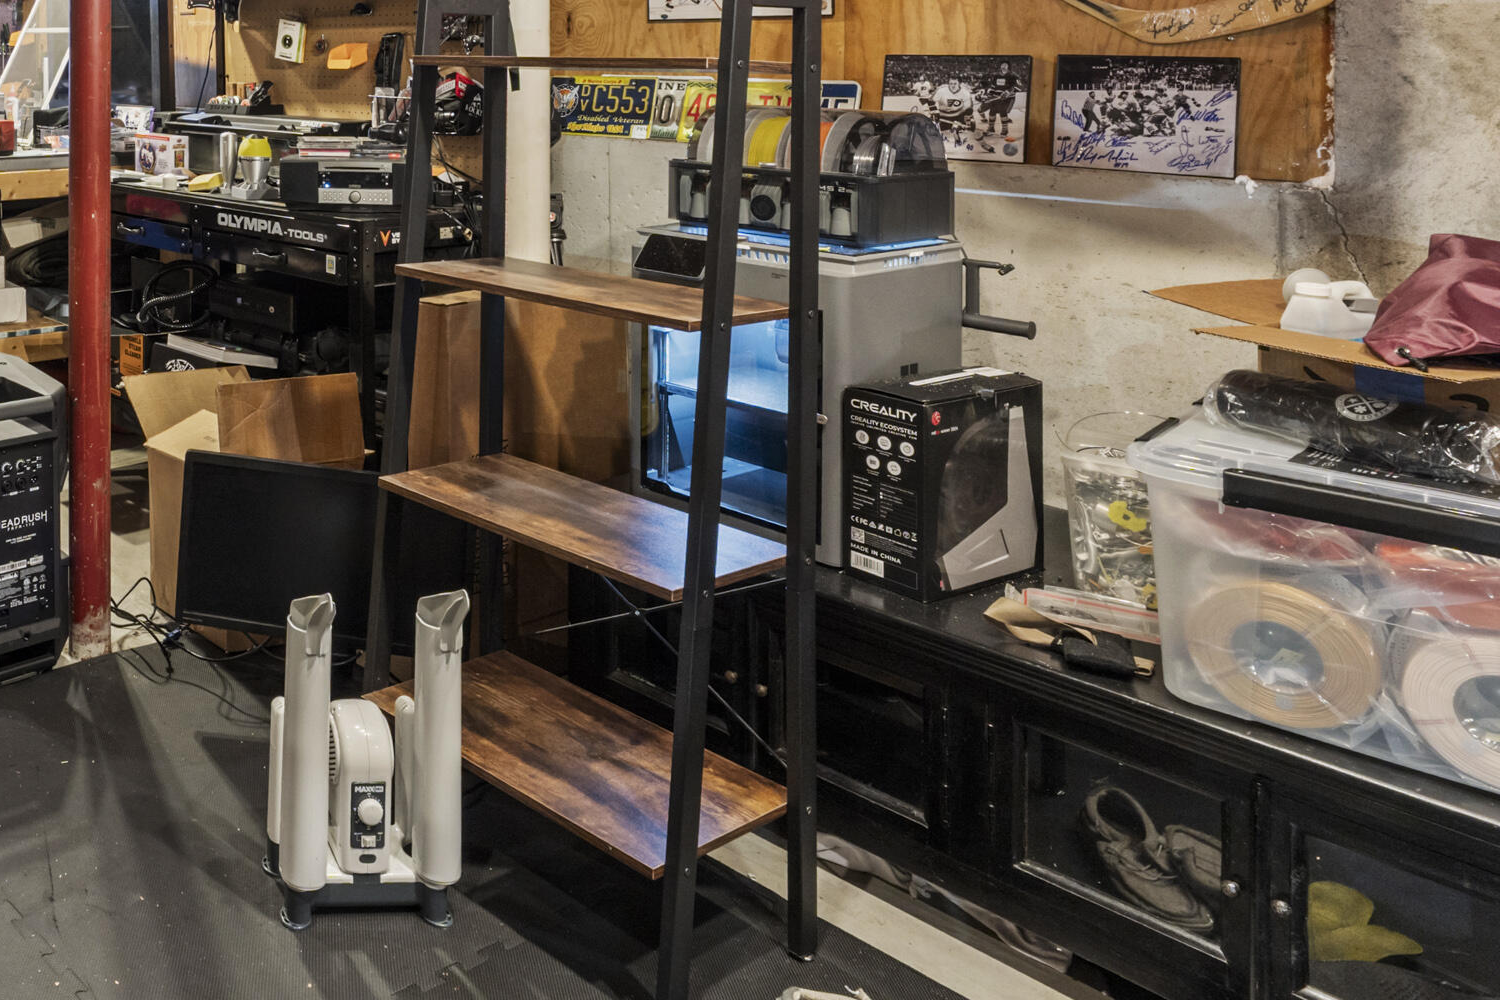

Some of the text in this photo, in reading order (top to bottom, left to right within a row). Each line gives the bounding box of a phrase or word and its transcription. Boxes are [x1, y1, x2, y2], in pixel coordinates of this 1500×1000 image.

[581, 85, 591, 97] D
[591, 85, 650, 114] C553
[580, 99, 589, 112] V
[577, 114, 644, 124] Disabled Veteran
[606, 124, 624, 133] USA
[216, 212, 284, 236] OLYMPIA
[850, 398, 918, 422] CREALITY
[850, 414, 879, 426] CREALITY
[879, 422, 918, 437] ECOSYSTEM
[850, 542, 869, 554] MADE
[870, 549, 879, 557] IN
[879, 551, 902, 565] CHINA
